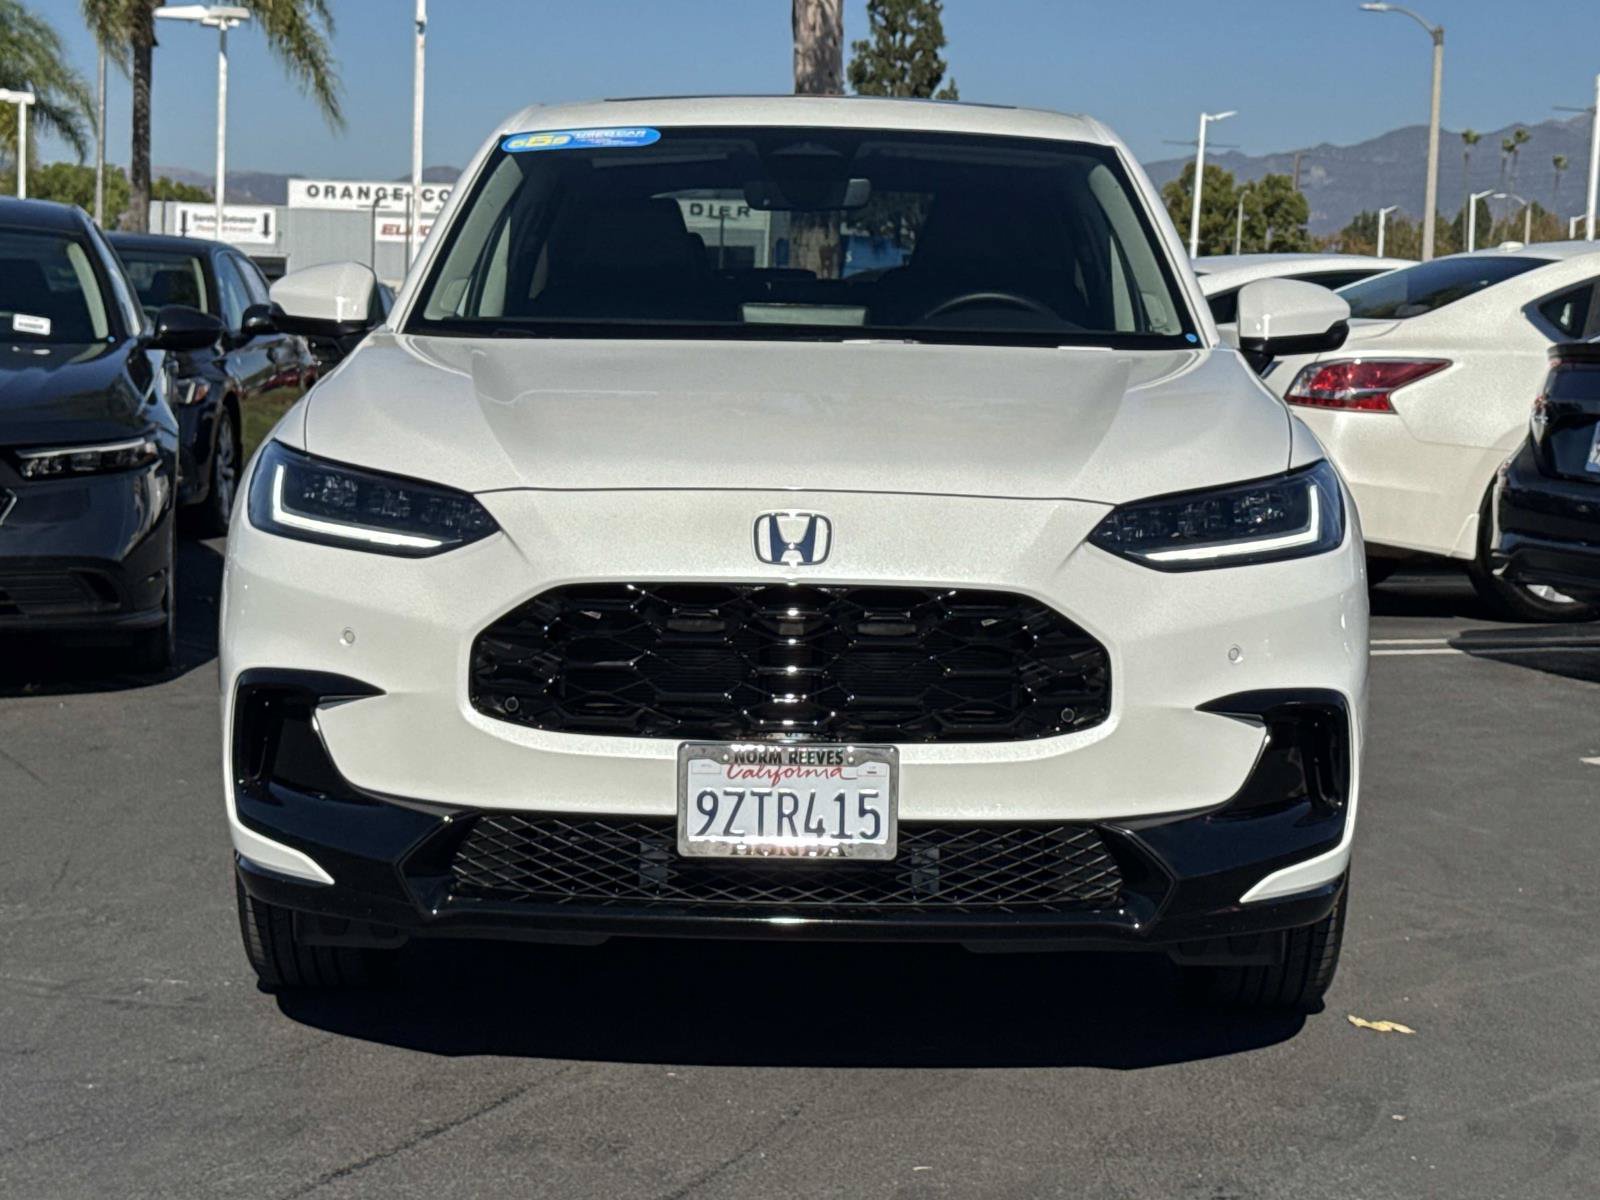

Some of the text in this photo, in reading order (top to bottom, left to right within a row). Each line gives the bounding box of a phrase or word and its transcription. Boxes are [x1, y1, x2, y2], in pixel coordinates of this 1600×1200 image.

[306, 184, 405, 200] ORANGE
[733, 748, 844, 766] NORM REEVES
[726, 764, 858, 787] California
[695, 787, 881, 840] 9ZTR415
